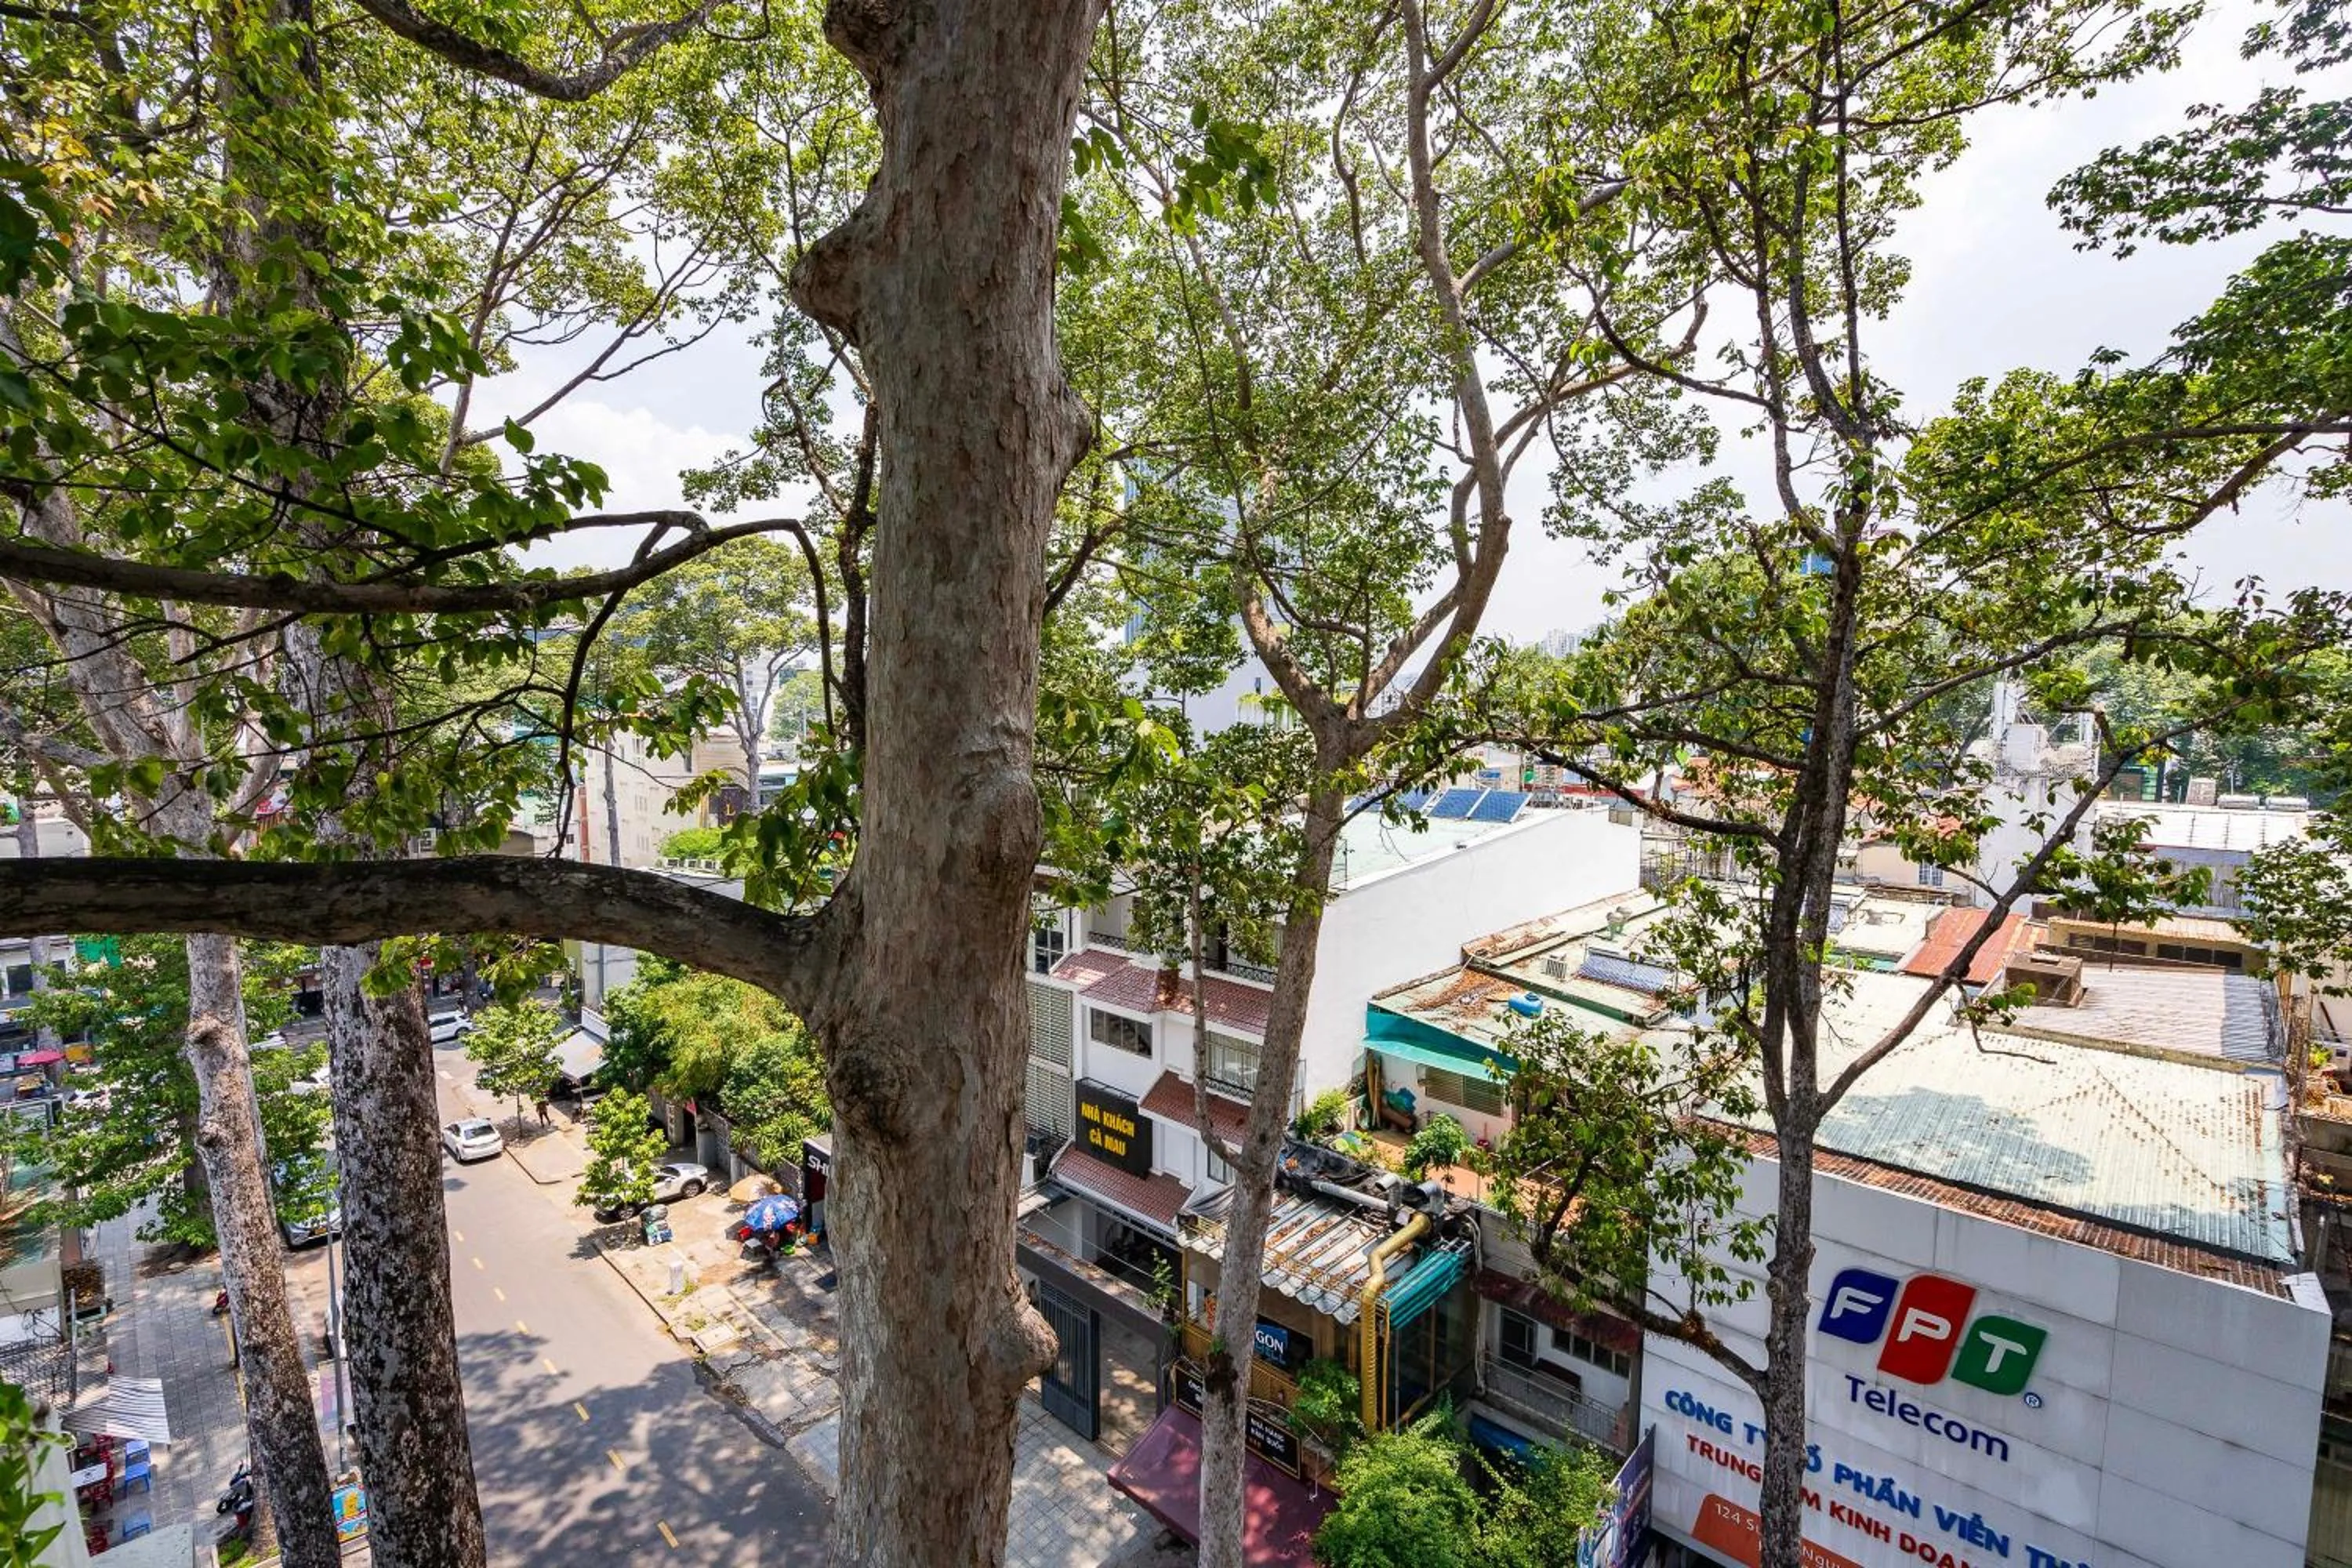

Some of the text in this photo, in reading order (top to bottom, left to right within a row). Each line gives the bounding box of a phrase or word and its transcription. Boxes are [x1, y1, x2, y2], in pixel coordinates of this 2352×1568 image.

[1081, 1102, 1135, 1138] NHÀ KHÁCH
[1105, 1134, 1127, 1156] MAU
[1255, 1330, 1283, 1354] GON
[1829, 1286, 2029, 1374] FPT
[1664, 1390, 1733, 1435] CÔNG
[1845, 1374, 2010, 1462] Telecom
[1687, 1434, 1762, 1483] TRUNG
[1829, 1500, 1891, 1543] KINH
[1715, 1503, 1740, 1525] 124
